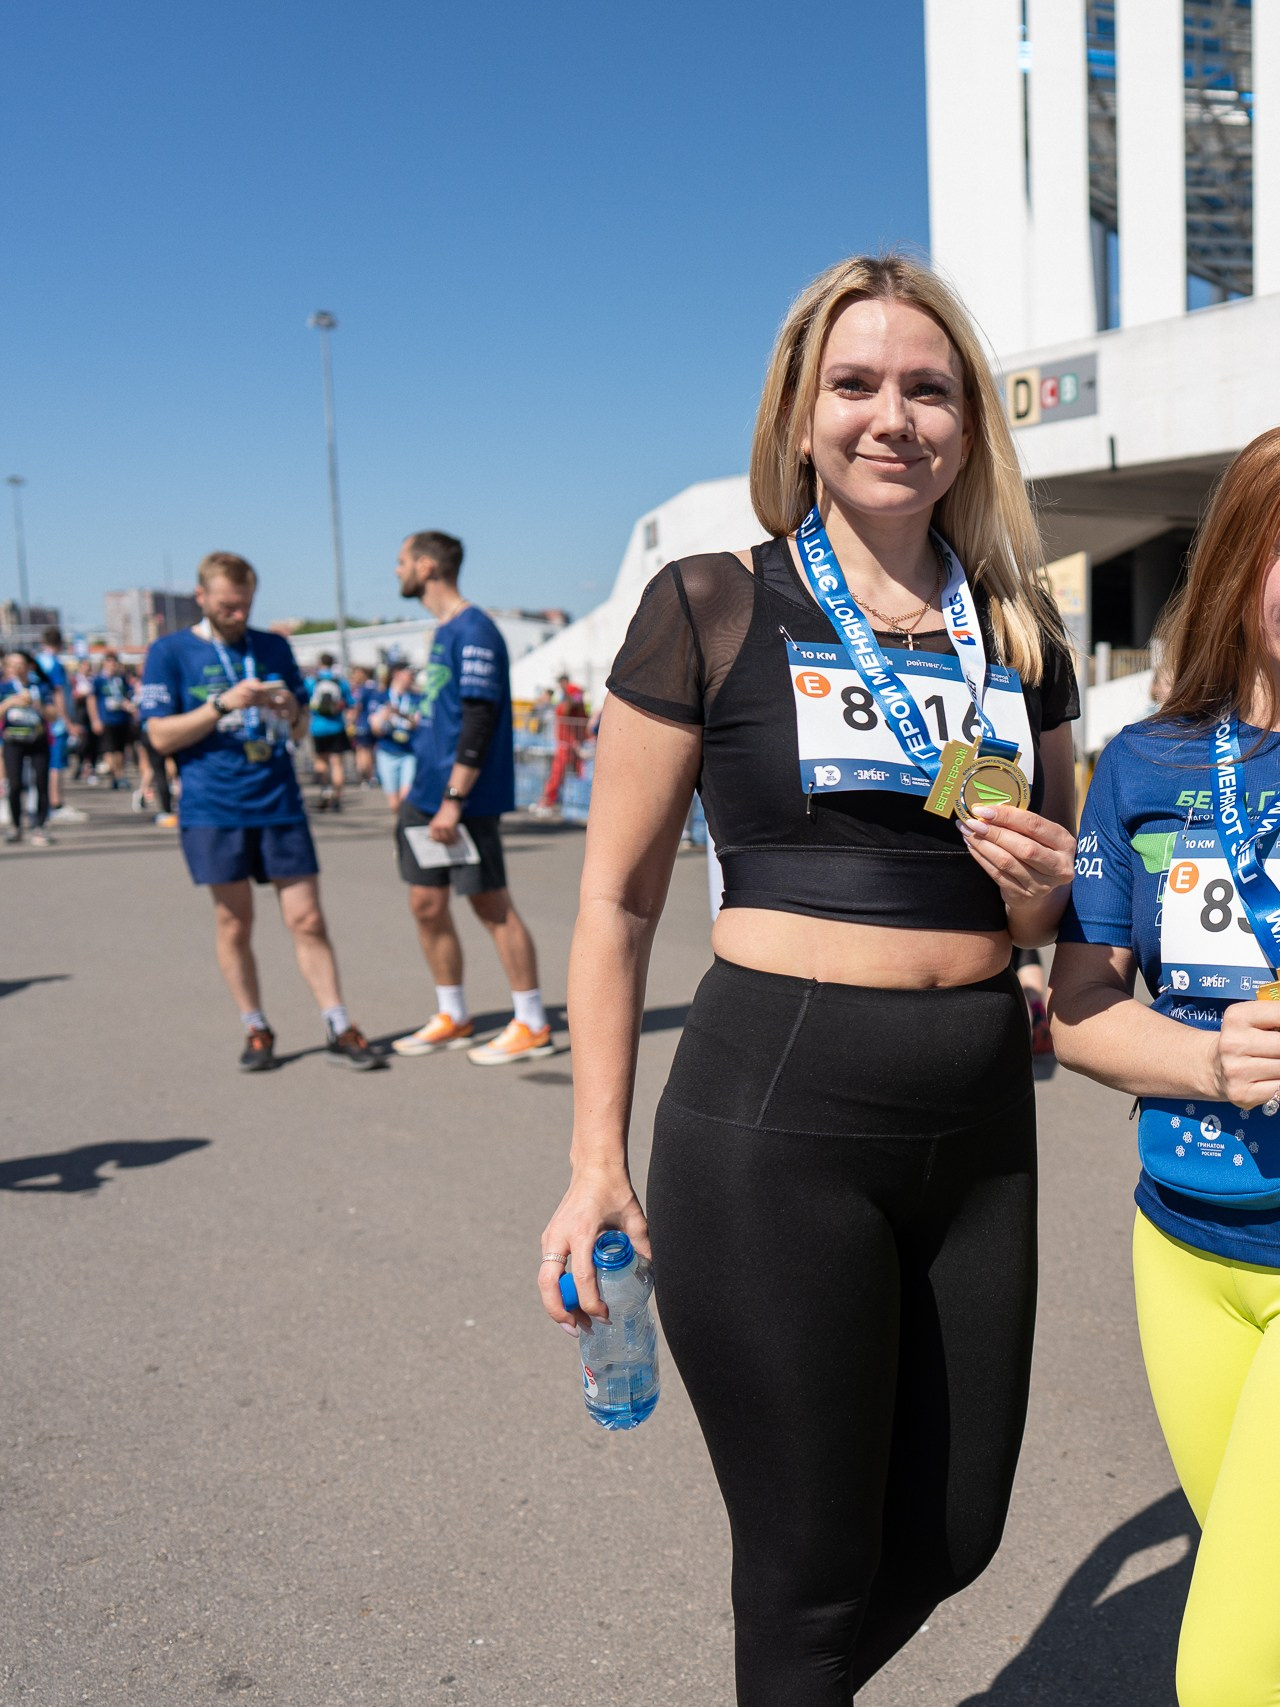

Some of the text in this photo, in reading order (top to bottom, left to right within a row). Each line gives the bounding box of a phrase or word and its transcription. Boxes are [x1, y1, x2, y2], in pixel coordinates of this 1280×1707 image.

[1014, 379, 1031, 419] D
[804, 539, 838, 592] ЭТОТ
[949, 592, 969, 628] ПСБ
[801, 651, 810, 659] 10
[826, 597, 892, 686] МЕНЯЮТ
[841, 686, 981, 743] 816
[879, 685, 936, 759] ГЕРОИ
[946, 747, 968, 785] ГЕРОЙ!
[1185, 840, 1194, 848] 10
